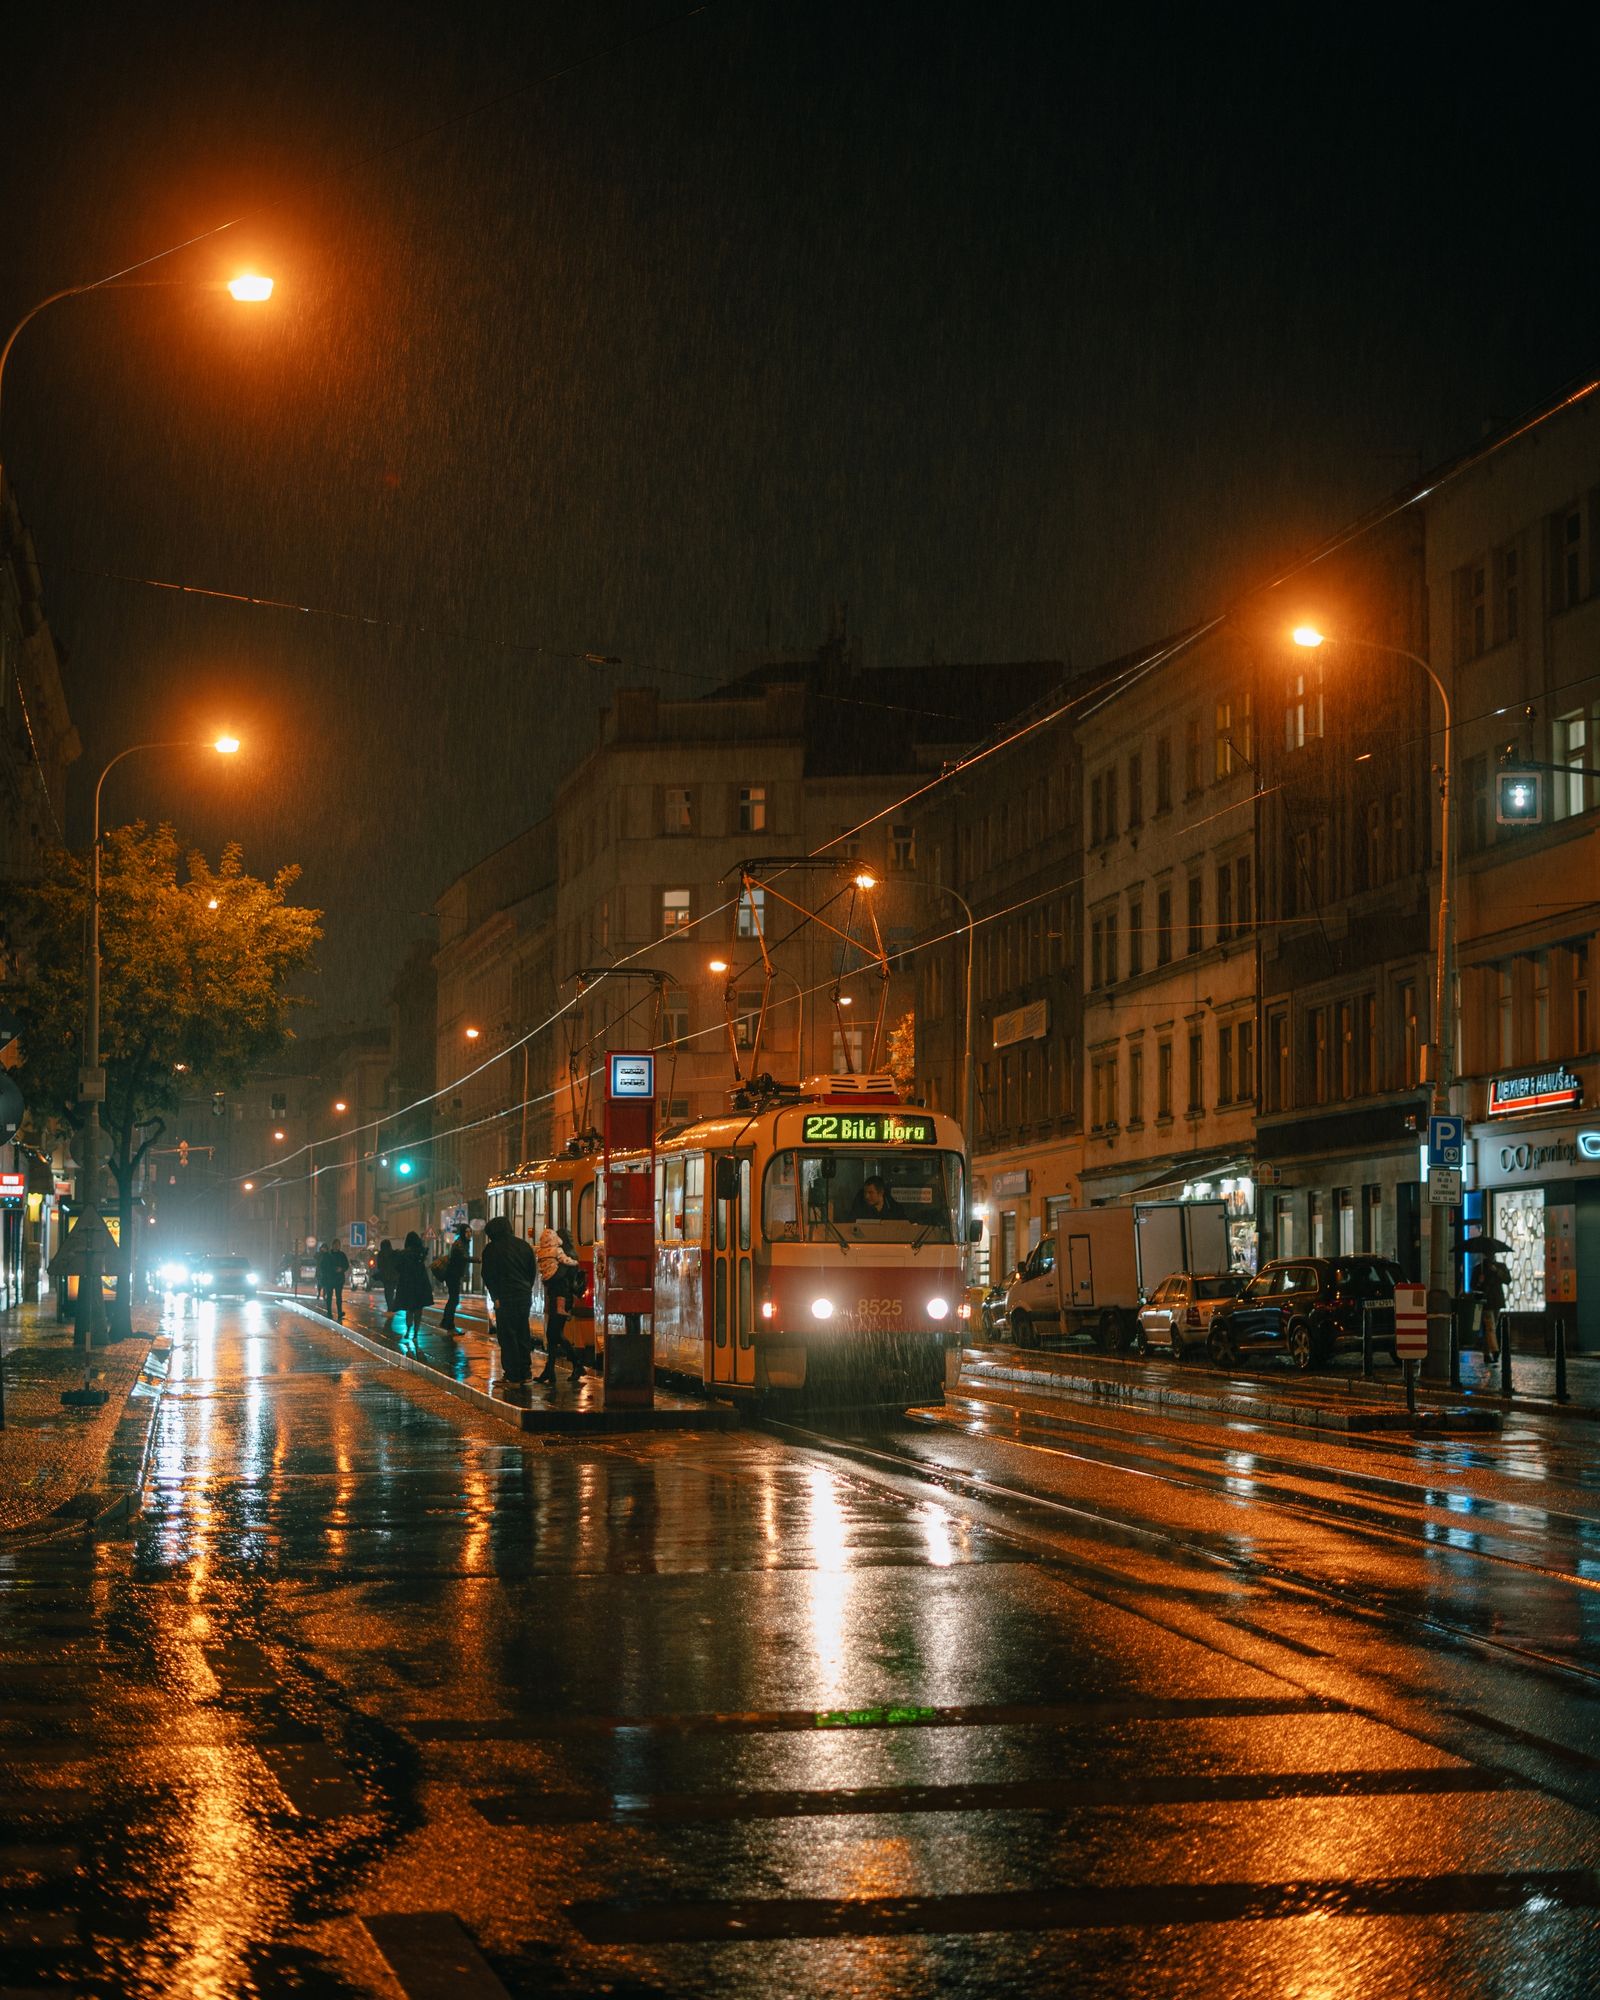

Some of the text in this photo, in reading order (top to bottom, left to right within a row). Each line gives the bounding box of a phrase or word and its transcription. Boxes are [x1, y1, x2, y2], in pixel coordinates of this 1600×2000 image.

[806, 1116, 925, 1140] 22 Bílá Hora
[1436, 1122, 1455, 1150] P
[858, 1298, 903, 1316] 8525
